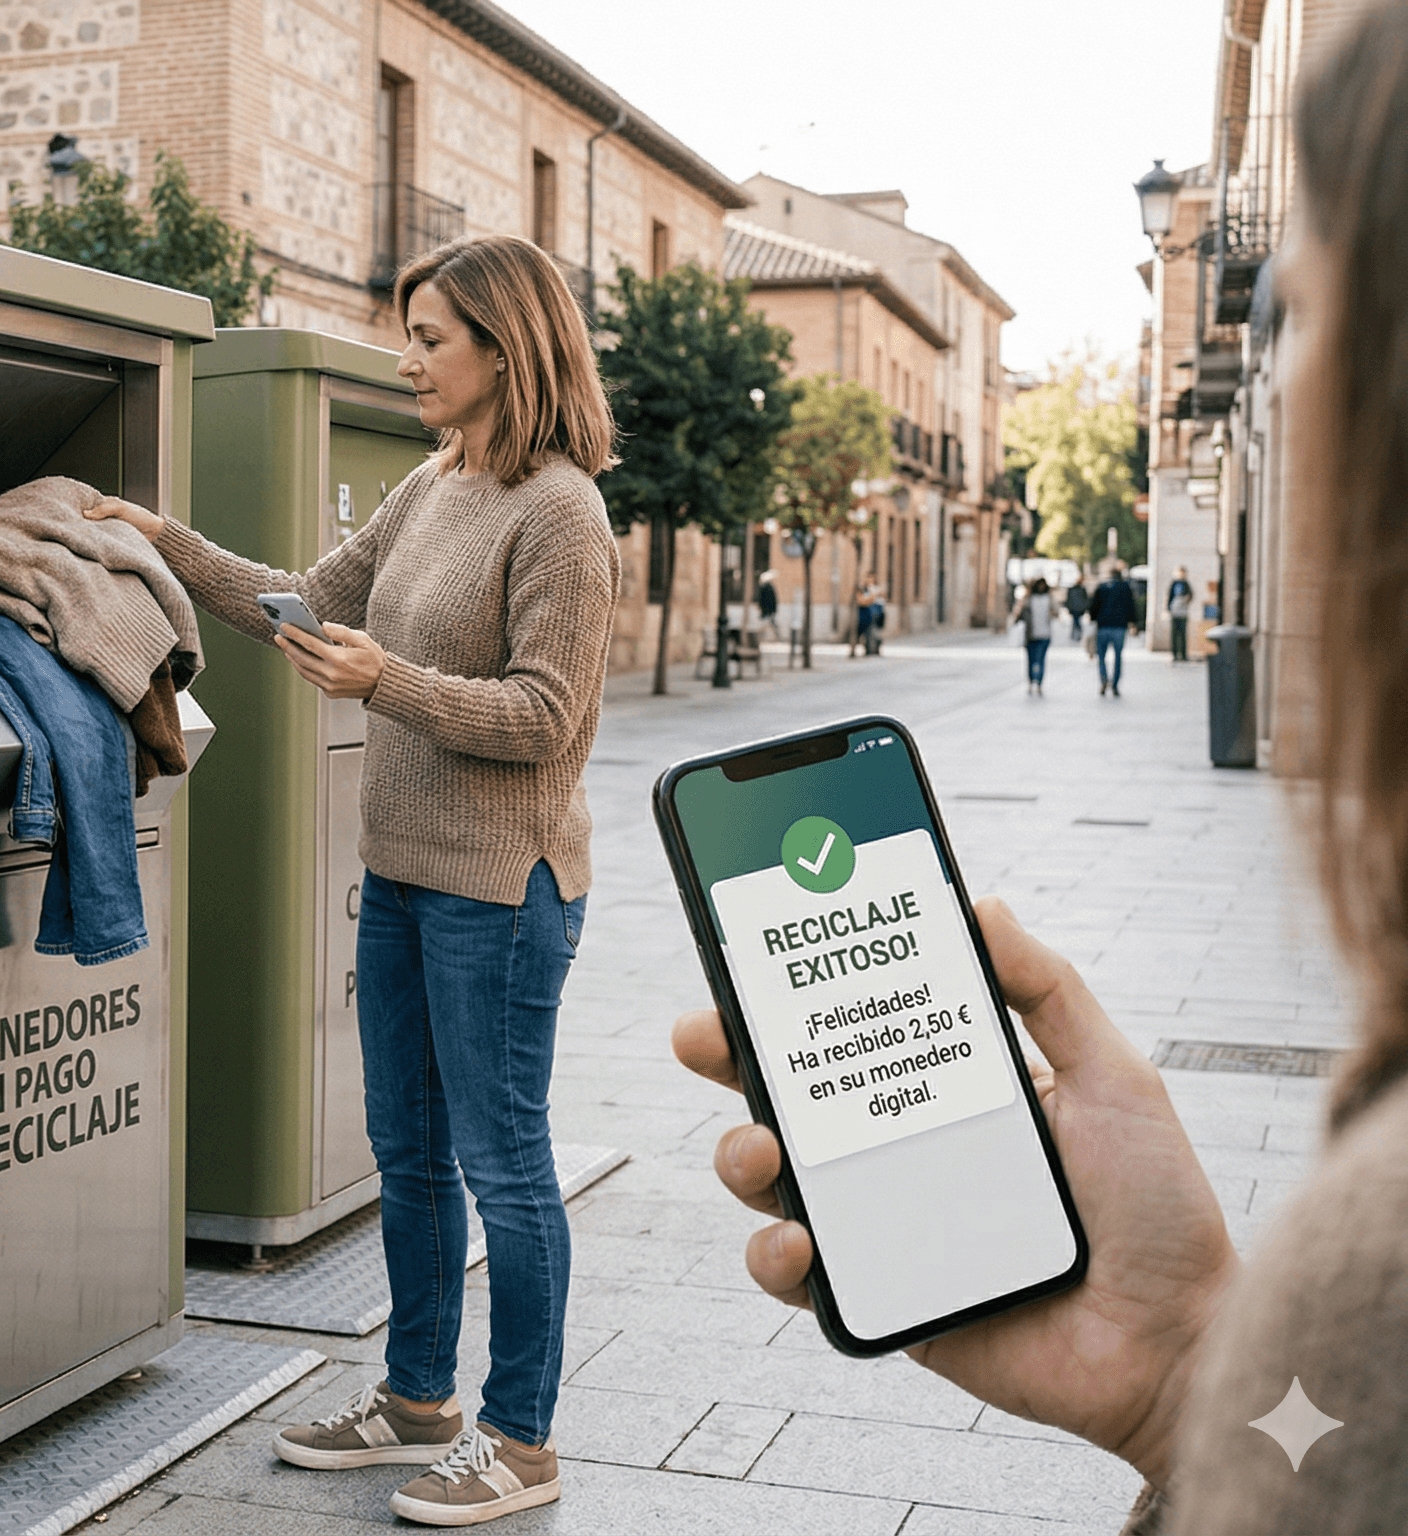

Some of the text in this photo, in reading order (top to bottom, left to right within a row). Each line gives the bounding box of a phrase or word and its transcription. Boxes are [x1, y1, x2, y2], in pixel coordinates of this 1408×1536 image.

[762, 891, 921, 956] RECICLAJE
[786, 931, 921, 990] EXITOSO!
[787, 1003, 973, 1074] Ha recibido 2,50 €
[805, 982, 933, 1040] ¡Felicidades!
[15, 1048, 97, 1109] PAGO
[809, 1041, 973, 1101] en su monedero
[868, 1079, 938, 1117] digital.
